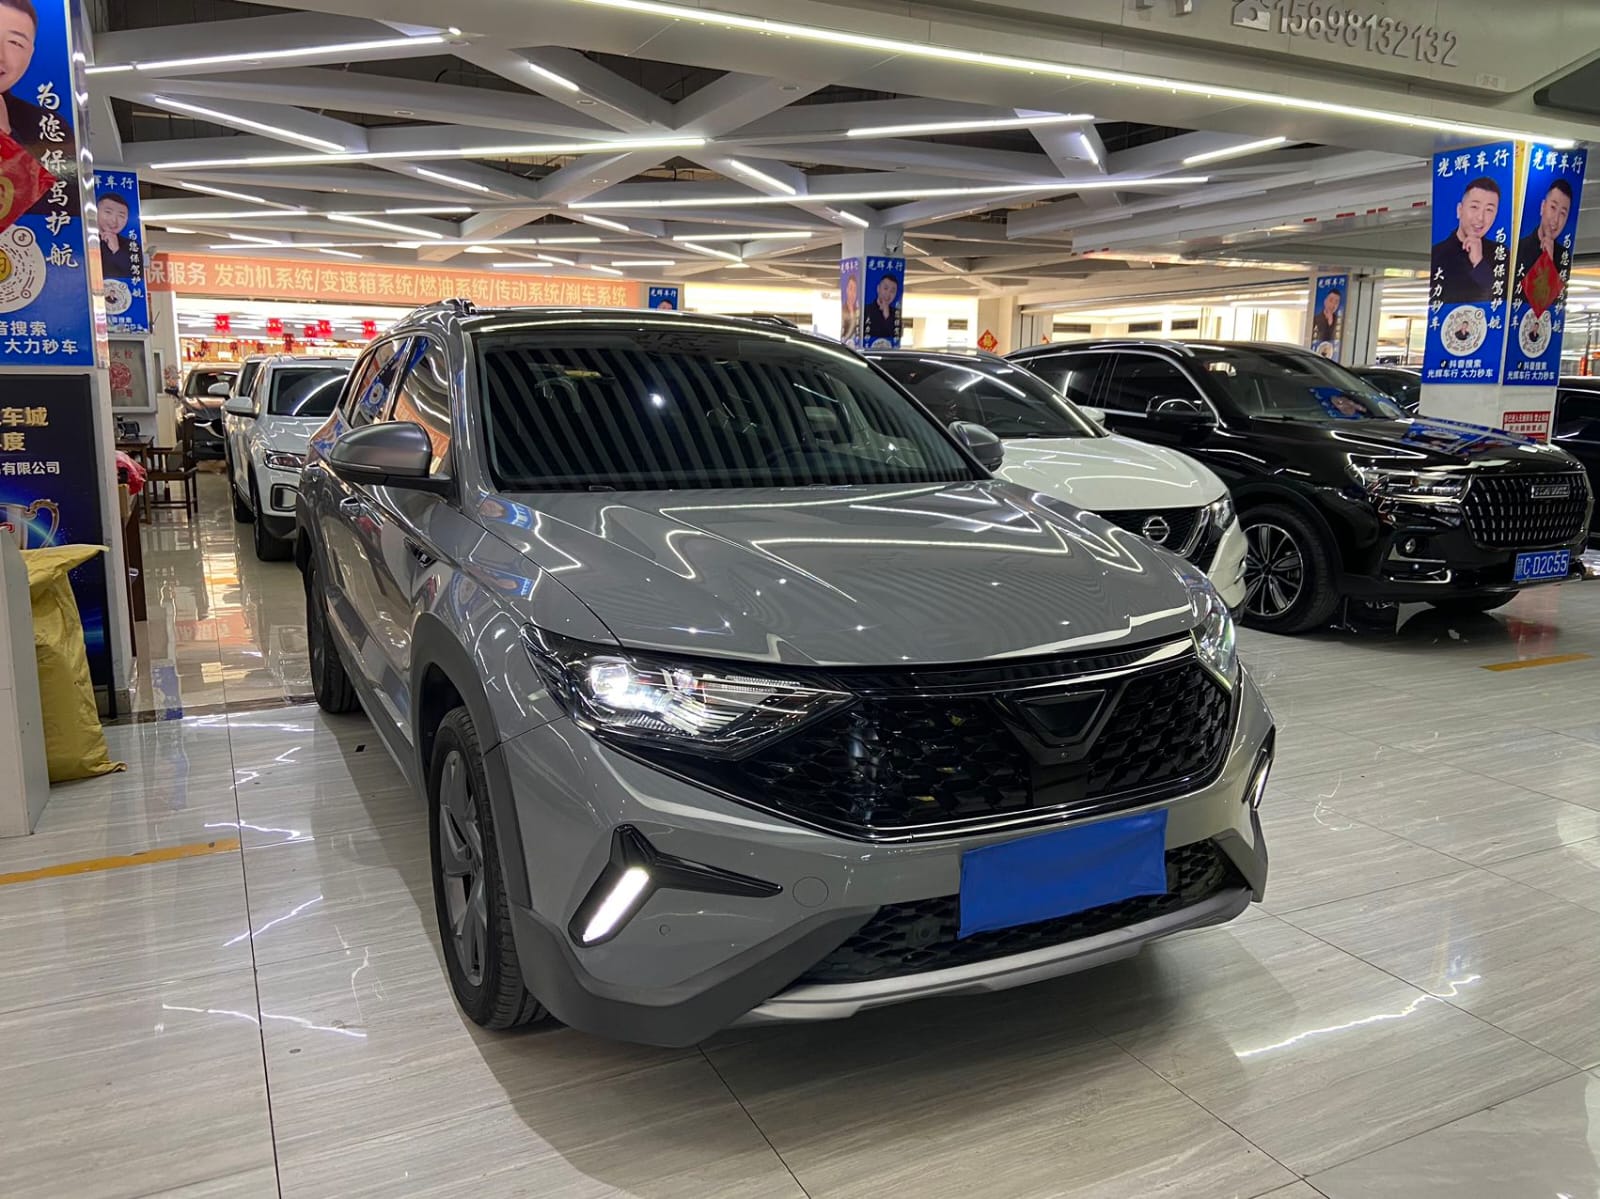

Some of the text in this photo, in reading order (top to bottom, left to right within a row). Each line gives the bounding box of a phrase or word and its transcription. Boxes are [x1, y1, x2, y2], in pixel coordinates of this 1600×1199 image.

[1273, 0, 1459, 67] 15898132132
[1437, 149, 1509, 177] 光辉车行
[1533, 149, 1584, 174] 光辉车行
[37, 82, 78, 268] 为您保驾护航
[1488, 227, 1507, 330] 为您保驾护航
[4, 338, 78, 355] 大力秒车
[0, 406, 49, 427] 车城
[0, 432, 26, 451] 度
[0, 461, 61, 476] 有限公司
